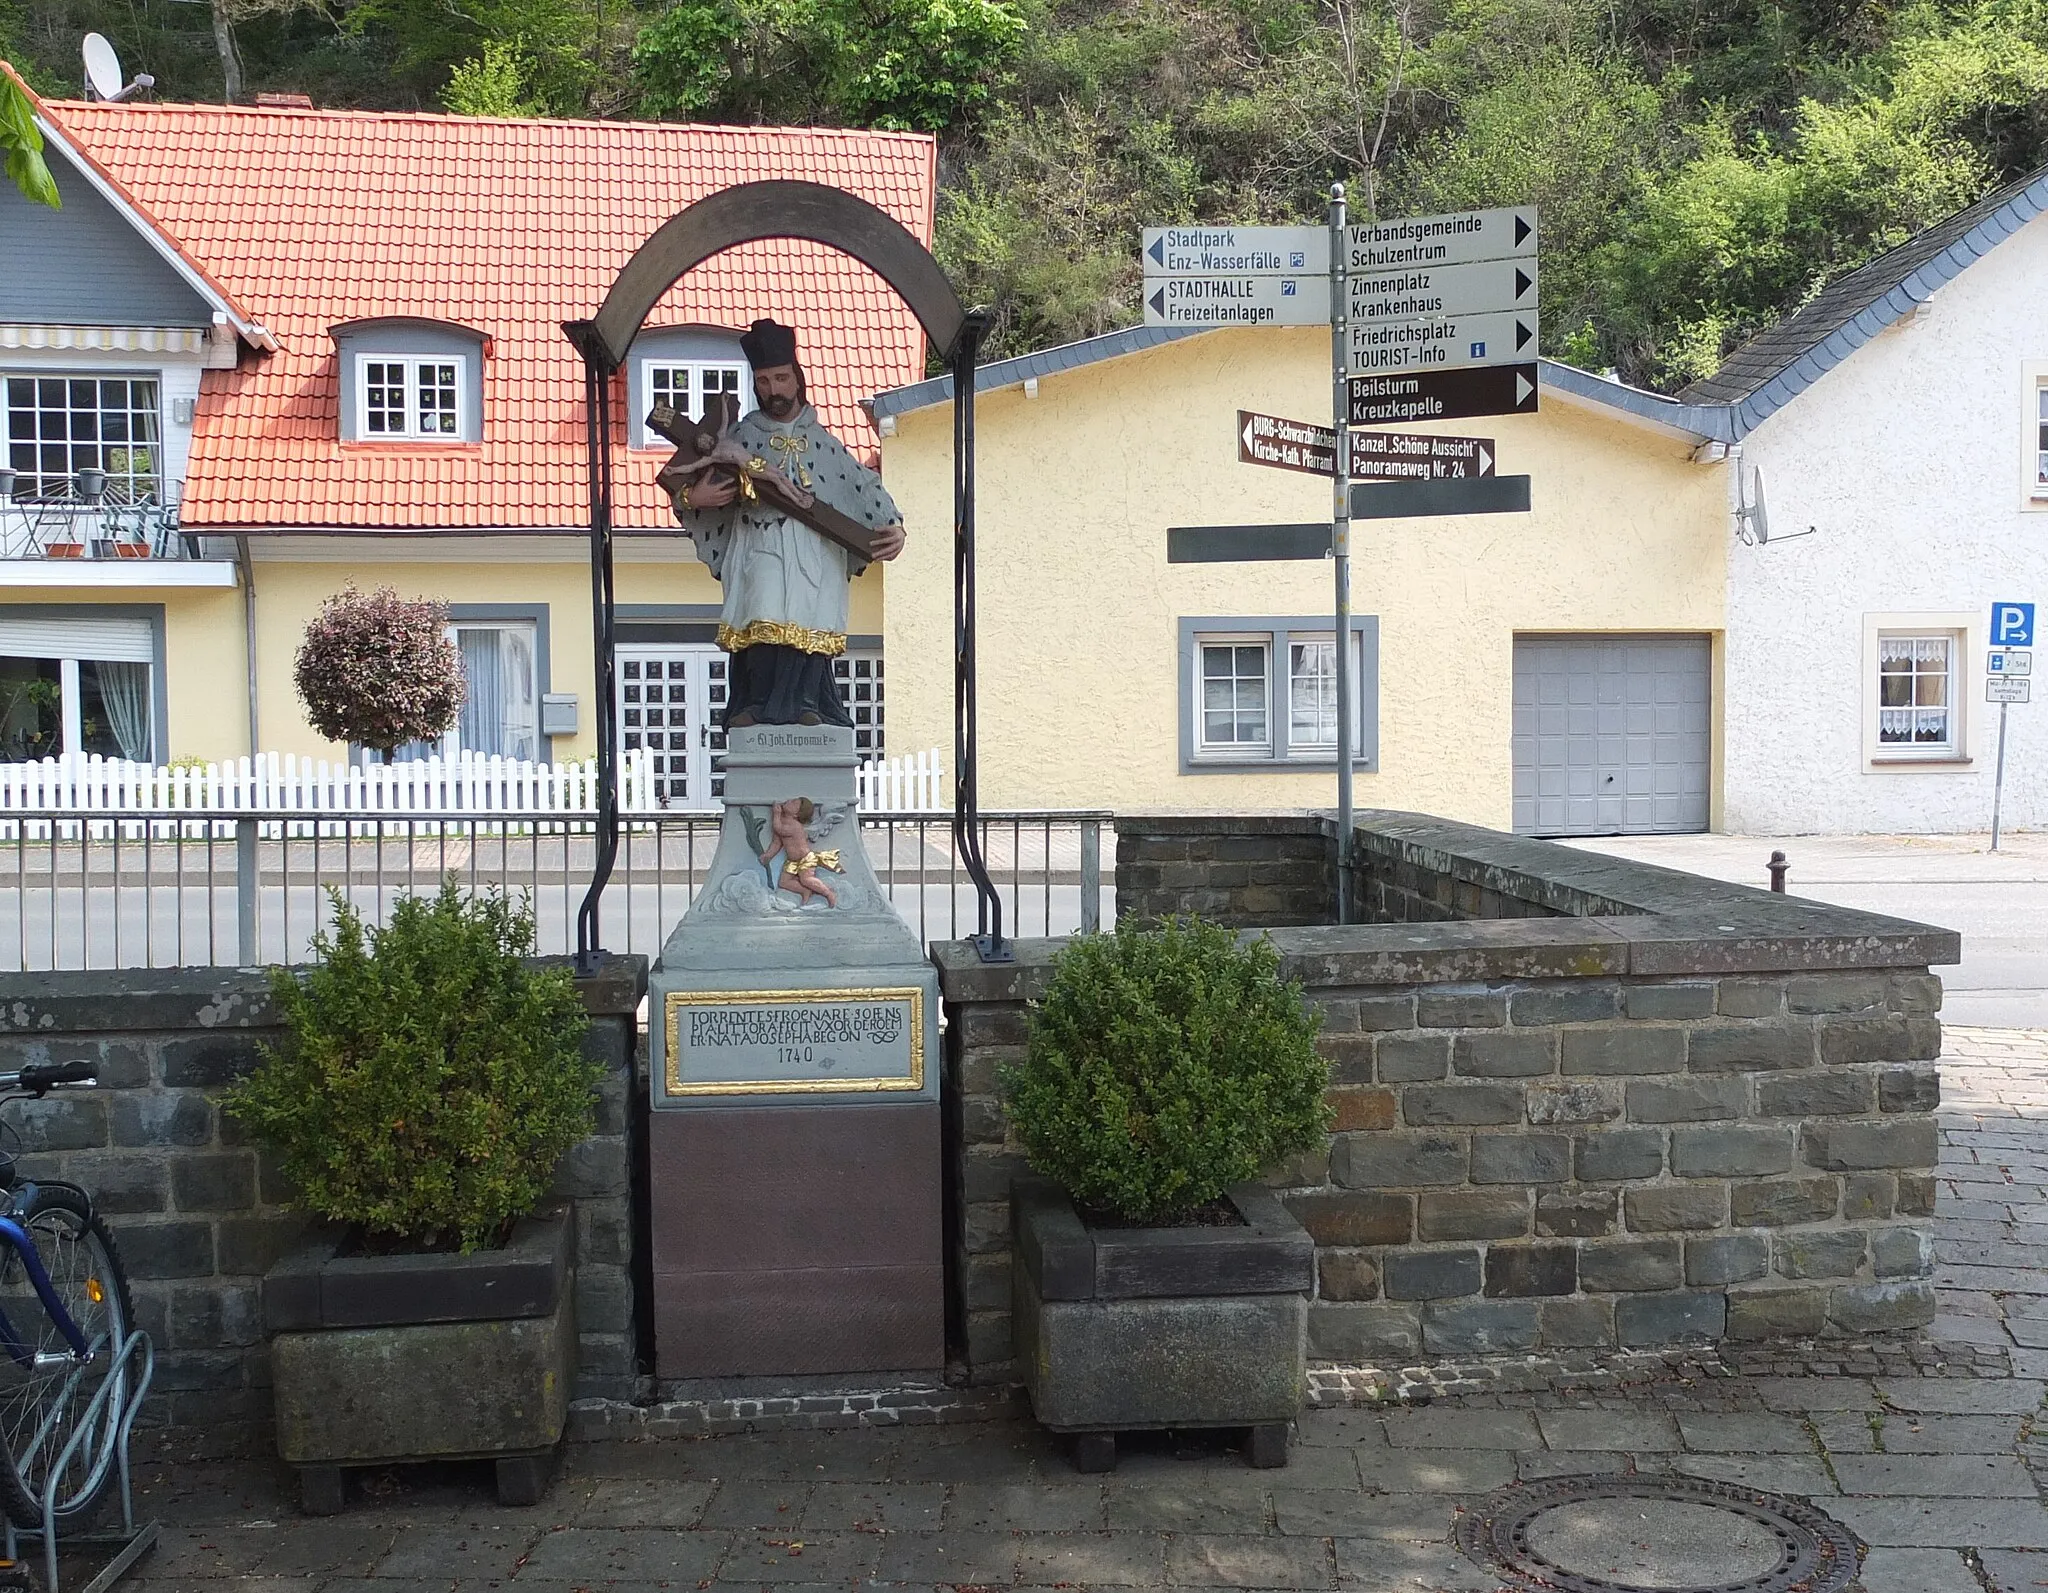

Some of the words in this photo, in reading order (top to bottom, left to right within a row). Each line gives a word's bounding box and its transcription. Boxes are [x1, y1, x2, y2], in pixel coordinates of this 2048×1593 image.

[1168, 230, 1235, 251] Stadtpark
[1351, 215, 1482, 244] Verbandsgemeinde
[1169, 251, 1281, 270] Enz-Wasserfälle
[1291, 253, 1304, 267] P5
[1351, 245, 1446, 267] Schulzentrum
[1169, 280, 1254, 298] STADTHALLE
[1282, 282, 1295, 295] P7
[1351, 273, 1430, 296] Zinnenplatz
[1169, 303, 1274, 324] Freizeitanlagen
[1352, 297, 1442, 318] Krankenhaus
[1353, 322, 1456, 346] Friedrichsplatz
[1353, 346, 1446, 368] TOURIST-Info
[1353, 379, 1419, 398] Beilsturm
[1353, 397, 1443, 420] Kreuzkapelle
[1353, 433, 1387, 453] Kanzel
[1302, 448, 1333, 471] Pfarramt
[1353, 456, 1430, 480] Panoramaweg
[1433, 460, 1449, 478] Nr.
[1452, 461, 1465, 478] 24
[2000, 607, 2025, 641] P
[777, 1046, 813, 1063] 1740
